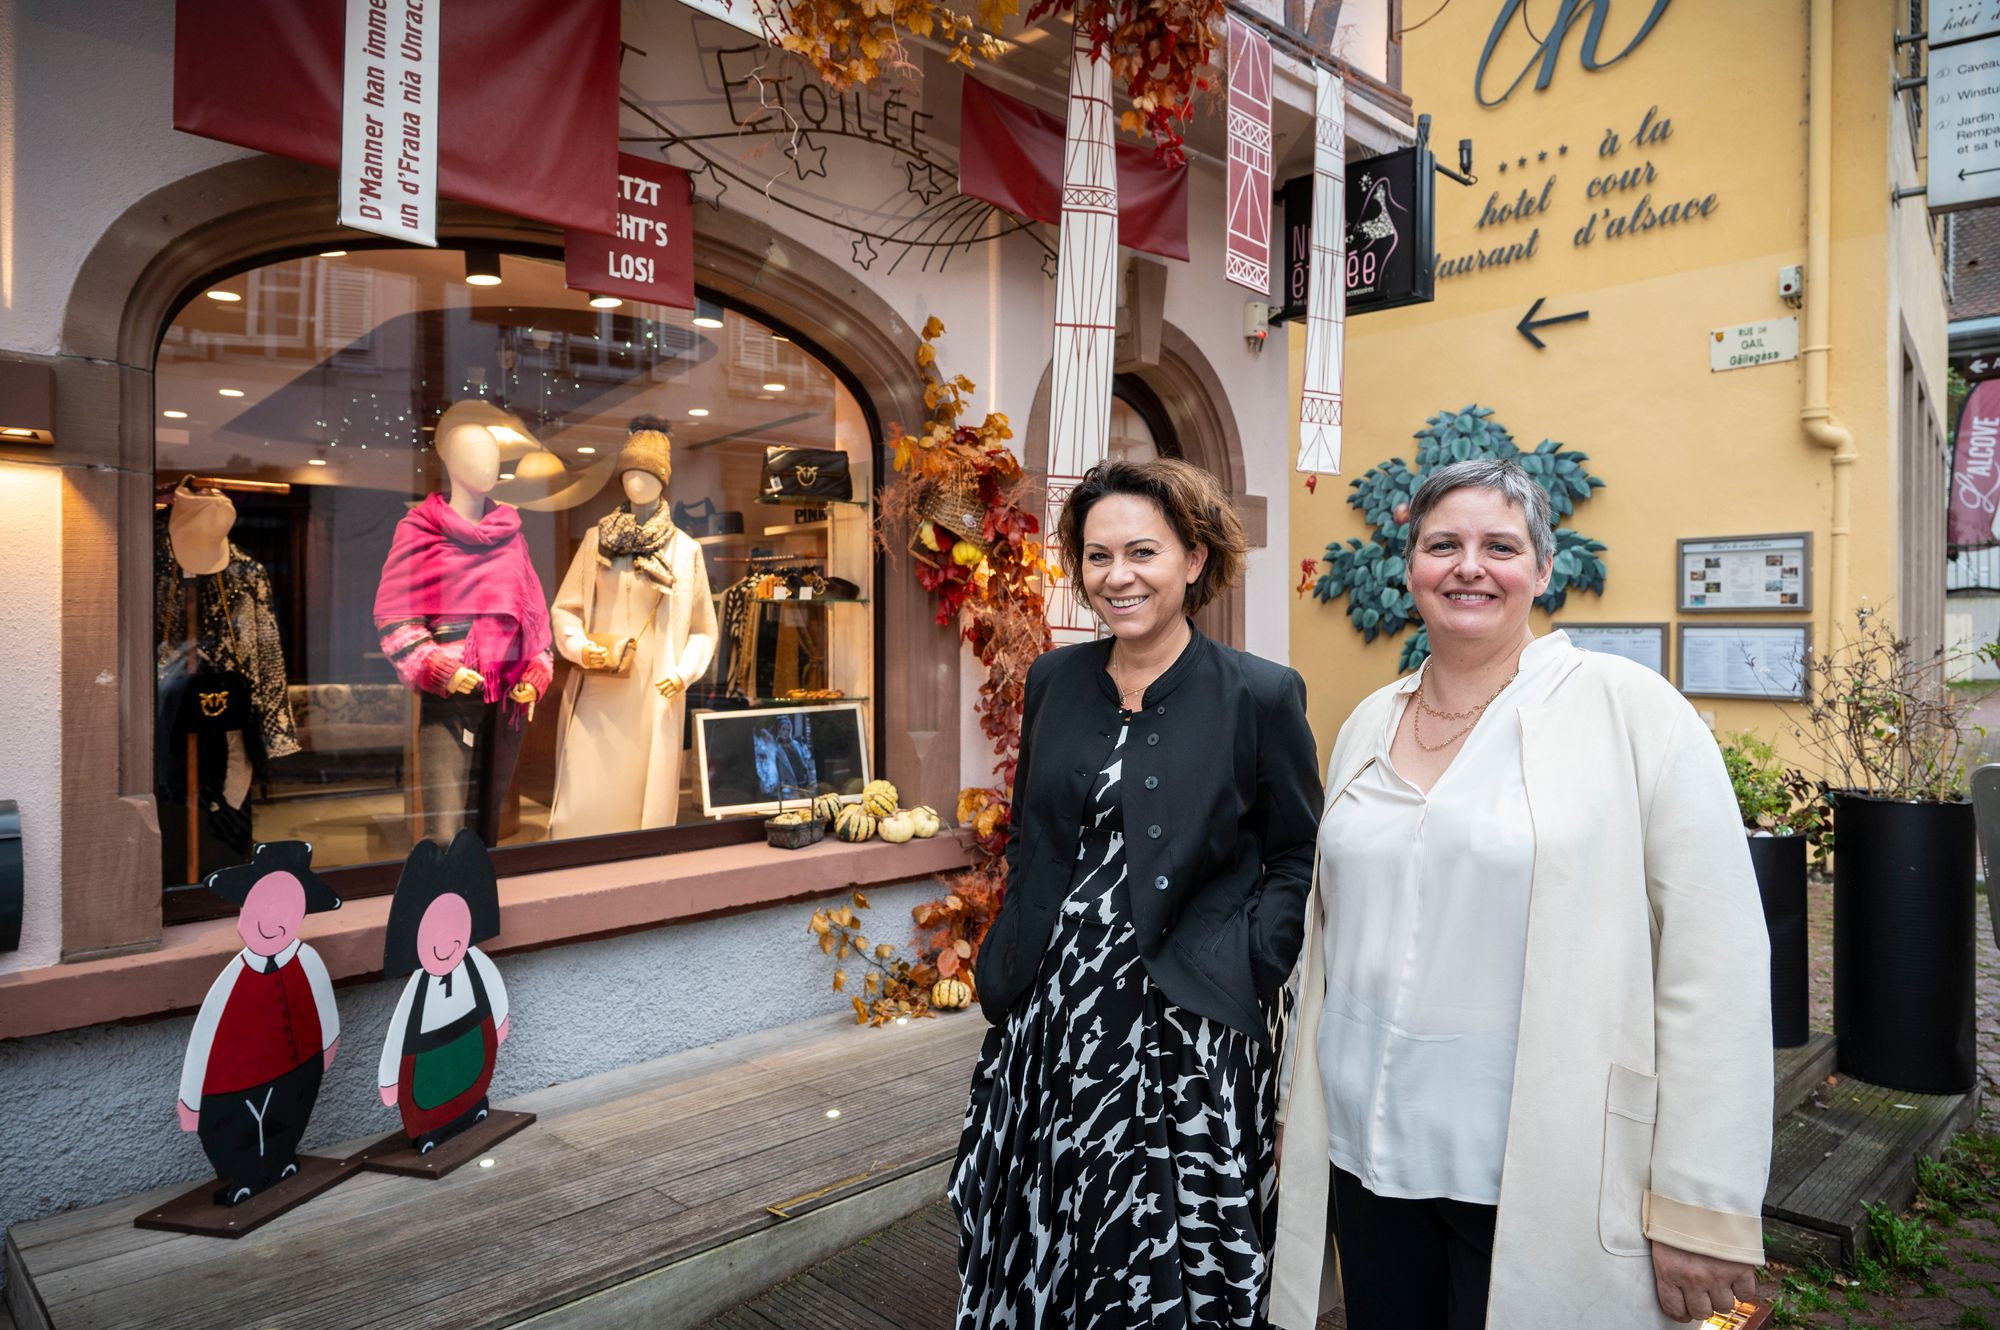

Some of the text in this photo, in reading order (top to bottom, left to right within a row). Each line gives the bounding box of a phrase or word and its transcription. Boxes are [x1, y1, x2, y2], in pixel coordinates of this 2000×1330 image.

[1942, 10, 1982, 33] hotel
[359, 0, 387, 220] D'Manner han imme
[1957, 86, 2000, 101] Winstu
[398, 0, 424, 229] un d'Fraua nia Unrac
[1599, 106, 1674, 157] à la
[1957, 112, 1995, 127] Jardin
[1957, 144, 1969, 154] et
[1974, 141, 1989, 152] sa
[617, 174, 662, 206] TZT
[1586, 161, 1658, 199] cour
[1474, 174, 1558, 230] hotel
[616, 212, 668, 247] HT'S
[1573, 193, 1720, 248] d'alsace
[608, 250, 655, 284] LOS!
[1433, 228, 1540, 282] taurant
[1738, 327, 1753, 337] RUE
[1741, 338, 1764, 350] GAIL
